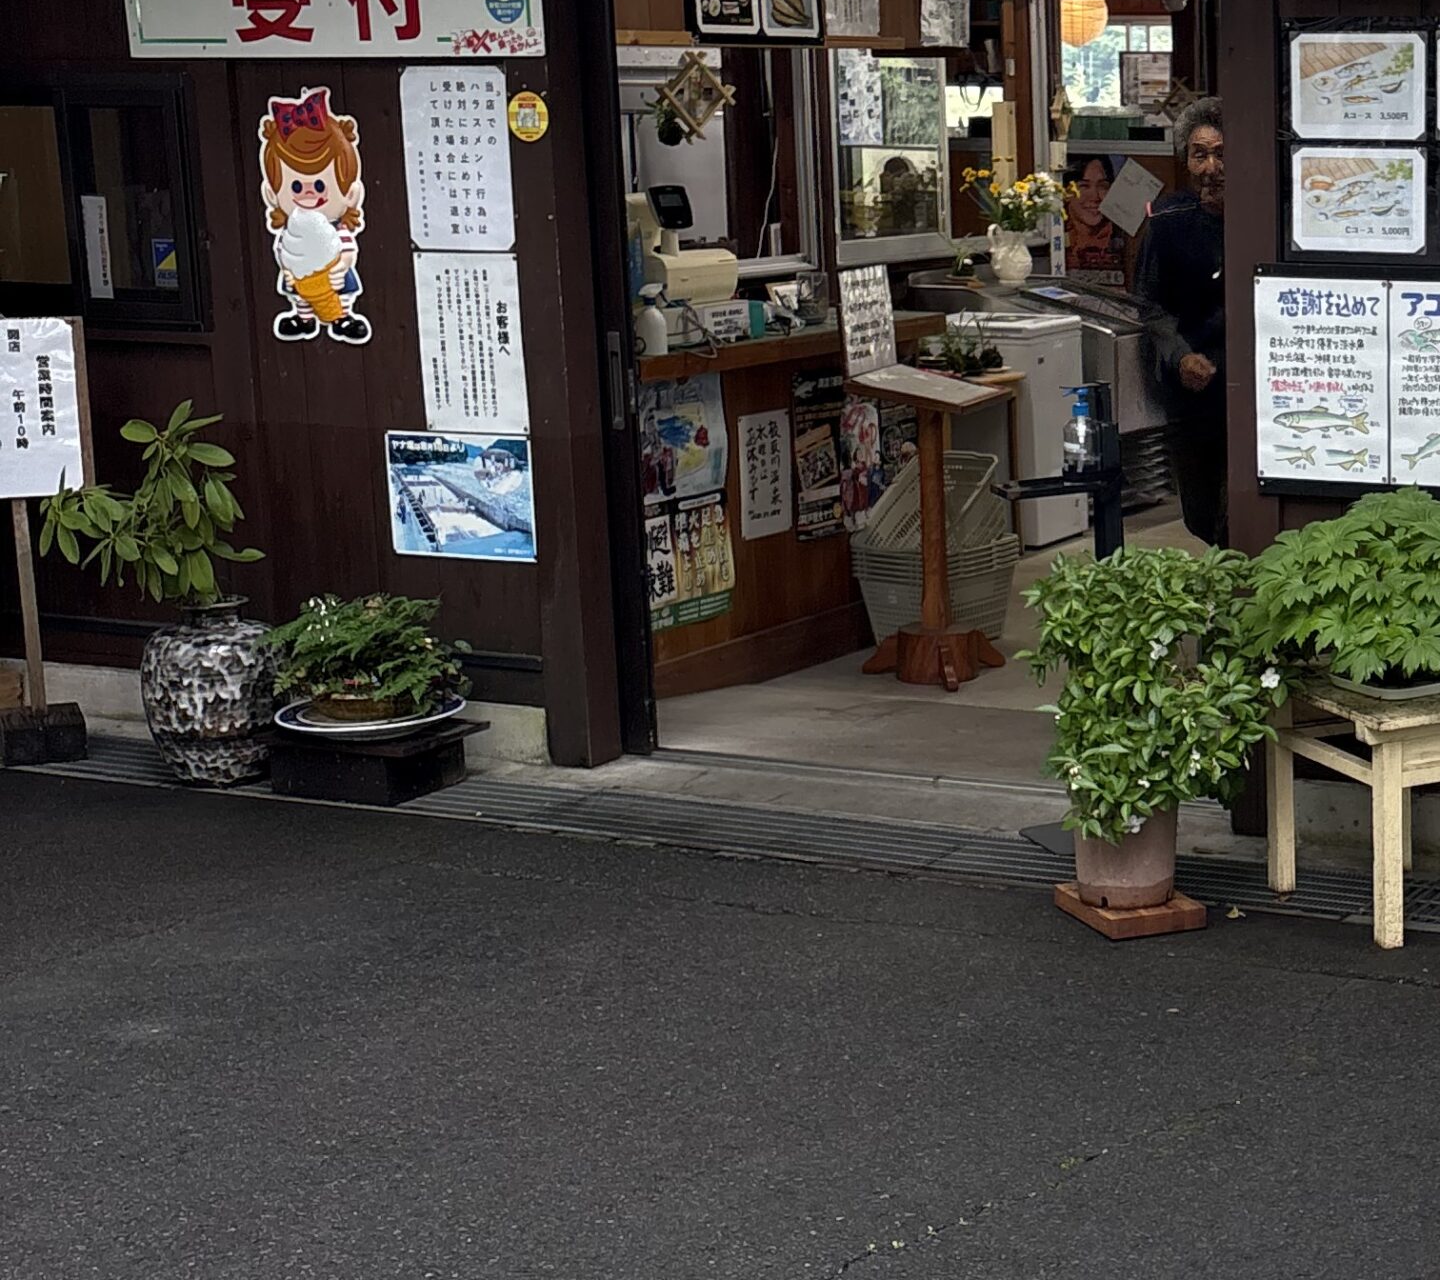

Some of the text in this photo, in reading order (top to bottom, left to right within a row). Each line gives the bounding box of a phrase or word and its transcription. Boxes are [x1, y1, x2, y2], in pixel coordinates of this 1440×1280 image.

[485, 81, 497, 145] 当店での
[1380, 111, 1408, 121] 3,500円
[456, 81, 474, 235] 絶対にお止め下さい
[470, 82, 488, 235] ハラスメント行為は
[1381, 226, 1410, 236] 5,000円
[496, 300, 511, 356] お客様へ
[1277, 287, 1380, 318] 感謝を込めて
[12, 389, 29, 450] 午前10時
[36, 355, 56, 437] 営業時間案内
